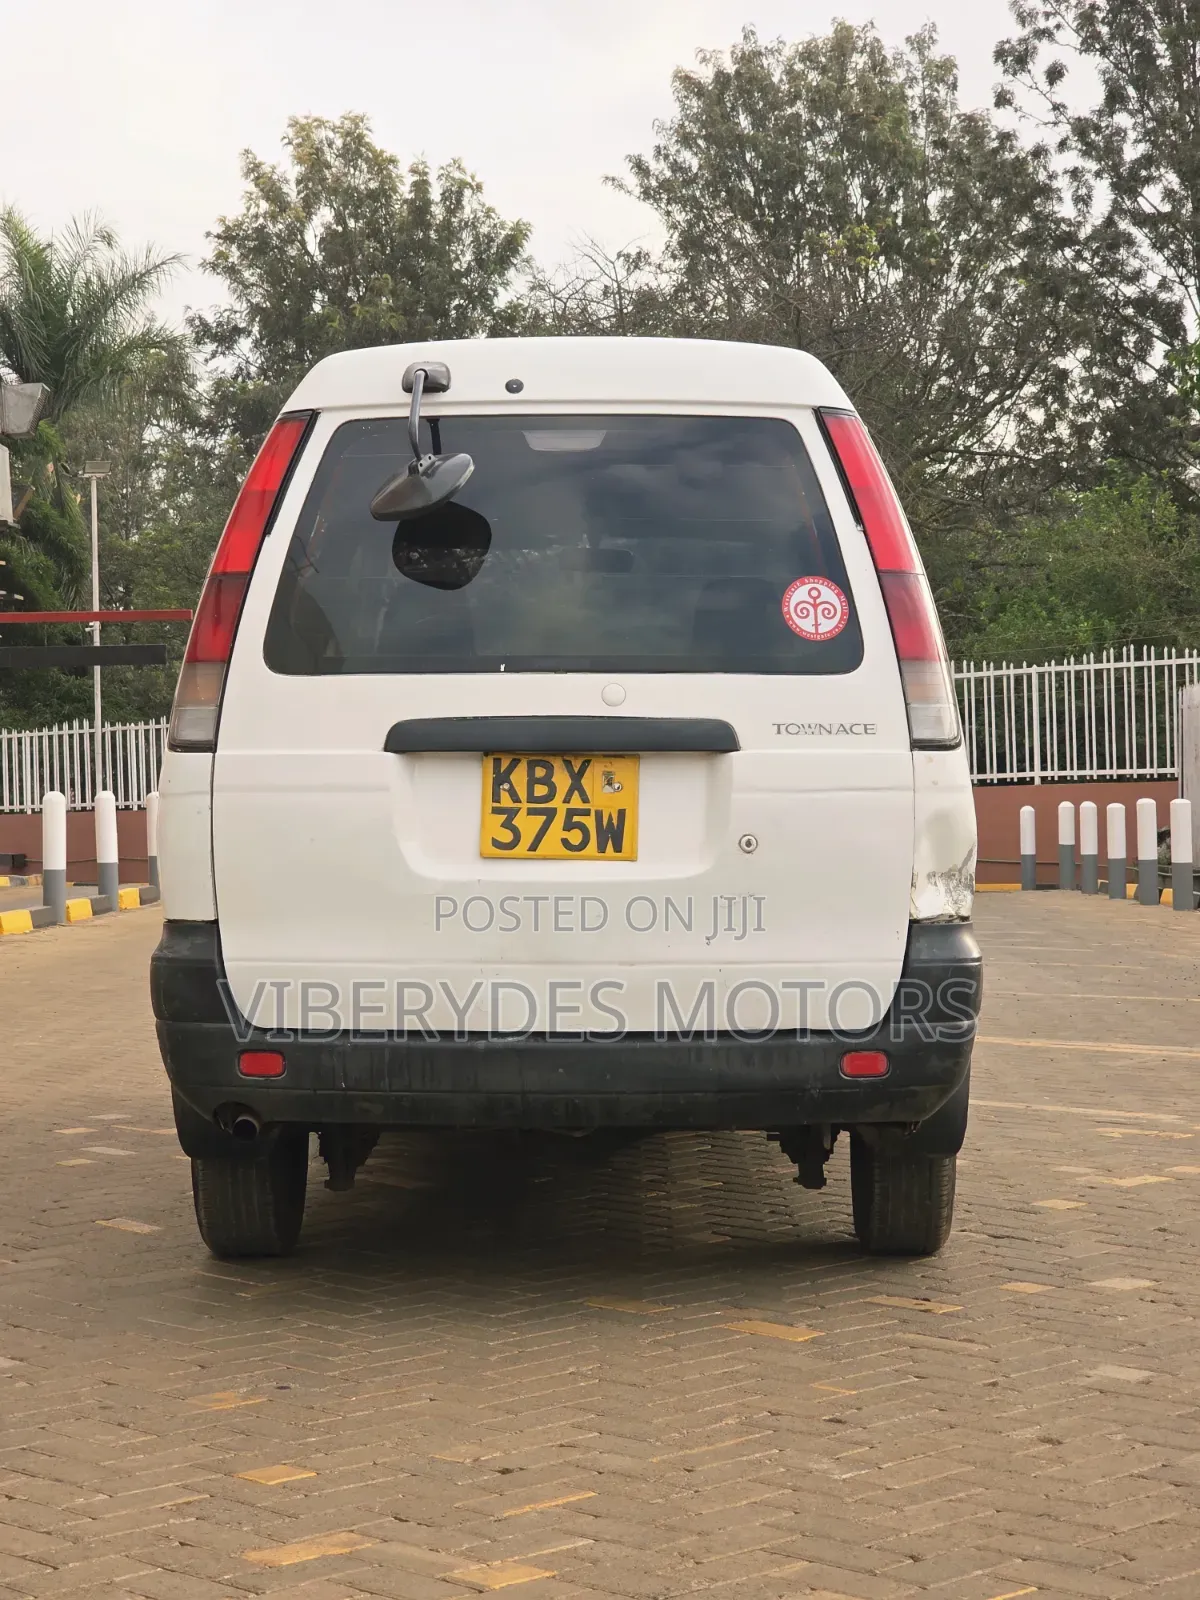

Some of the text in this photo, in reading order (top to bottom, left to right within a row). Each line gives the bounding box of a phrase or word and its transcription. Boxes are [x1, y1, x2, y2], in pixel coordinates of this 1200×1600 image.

[772, 723, 877, 735] TOWNACE
[491, 757, 592, 804] KBX
[491, 806, 626, 853] 375W
